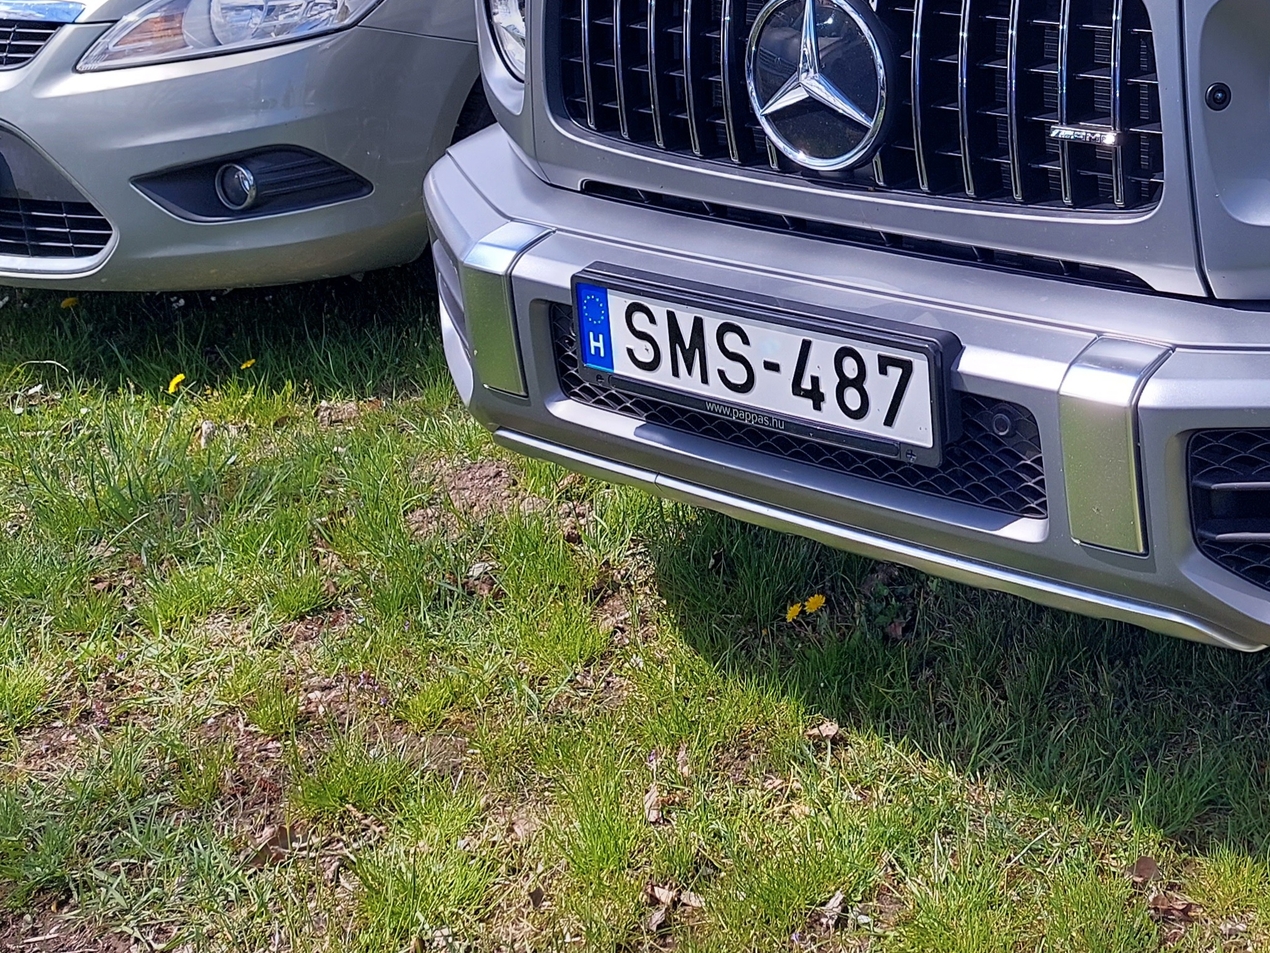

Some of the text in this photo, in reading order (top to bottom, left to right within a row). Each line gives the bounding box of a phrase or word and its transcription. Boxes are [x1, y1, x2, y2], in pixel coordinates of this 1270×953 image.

[589, 301, 914, 428] H SMS-487
[705, 401, 785, 429] www.pappas.hu
